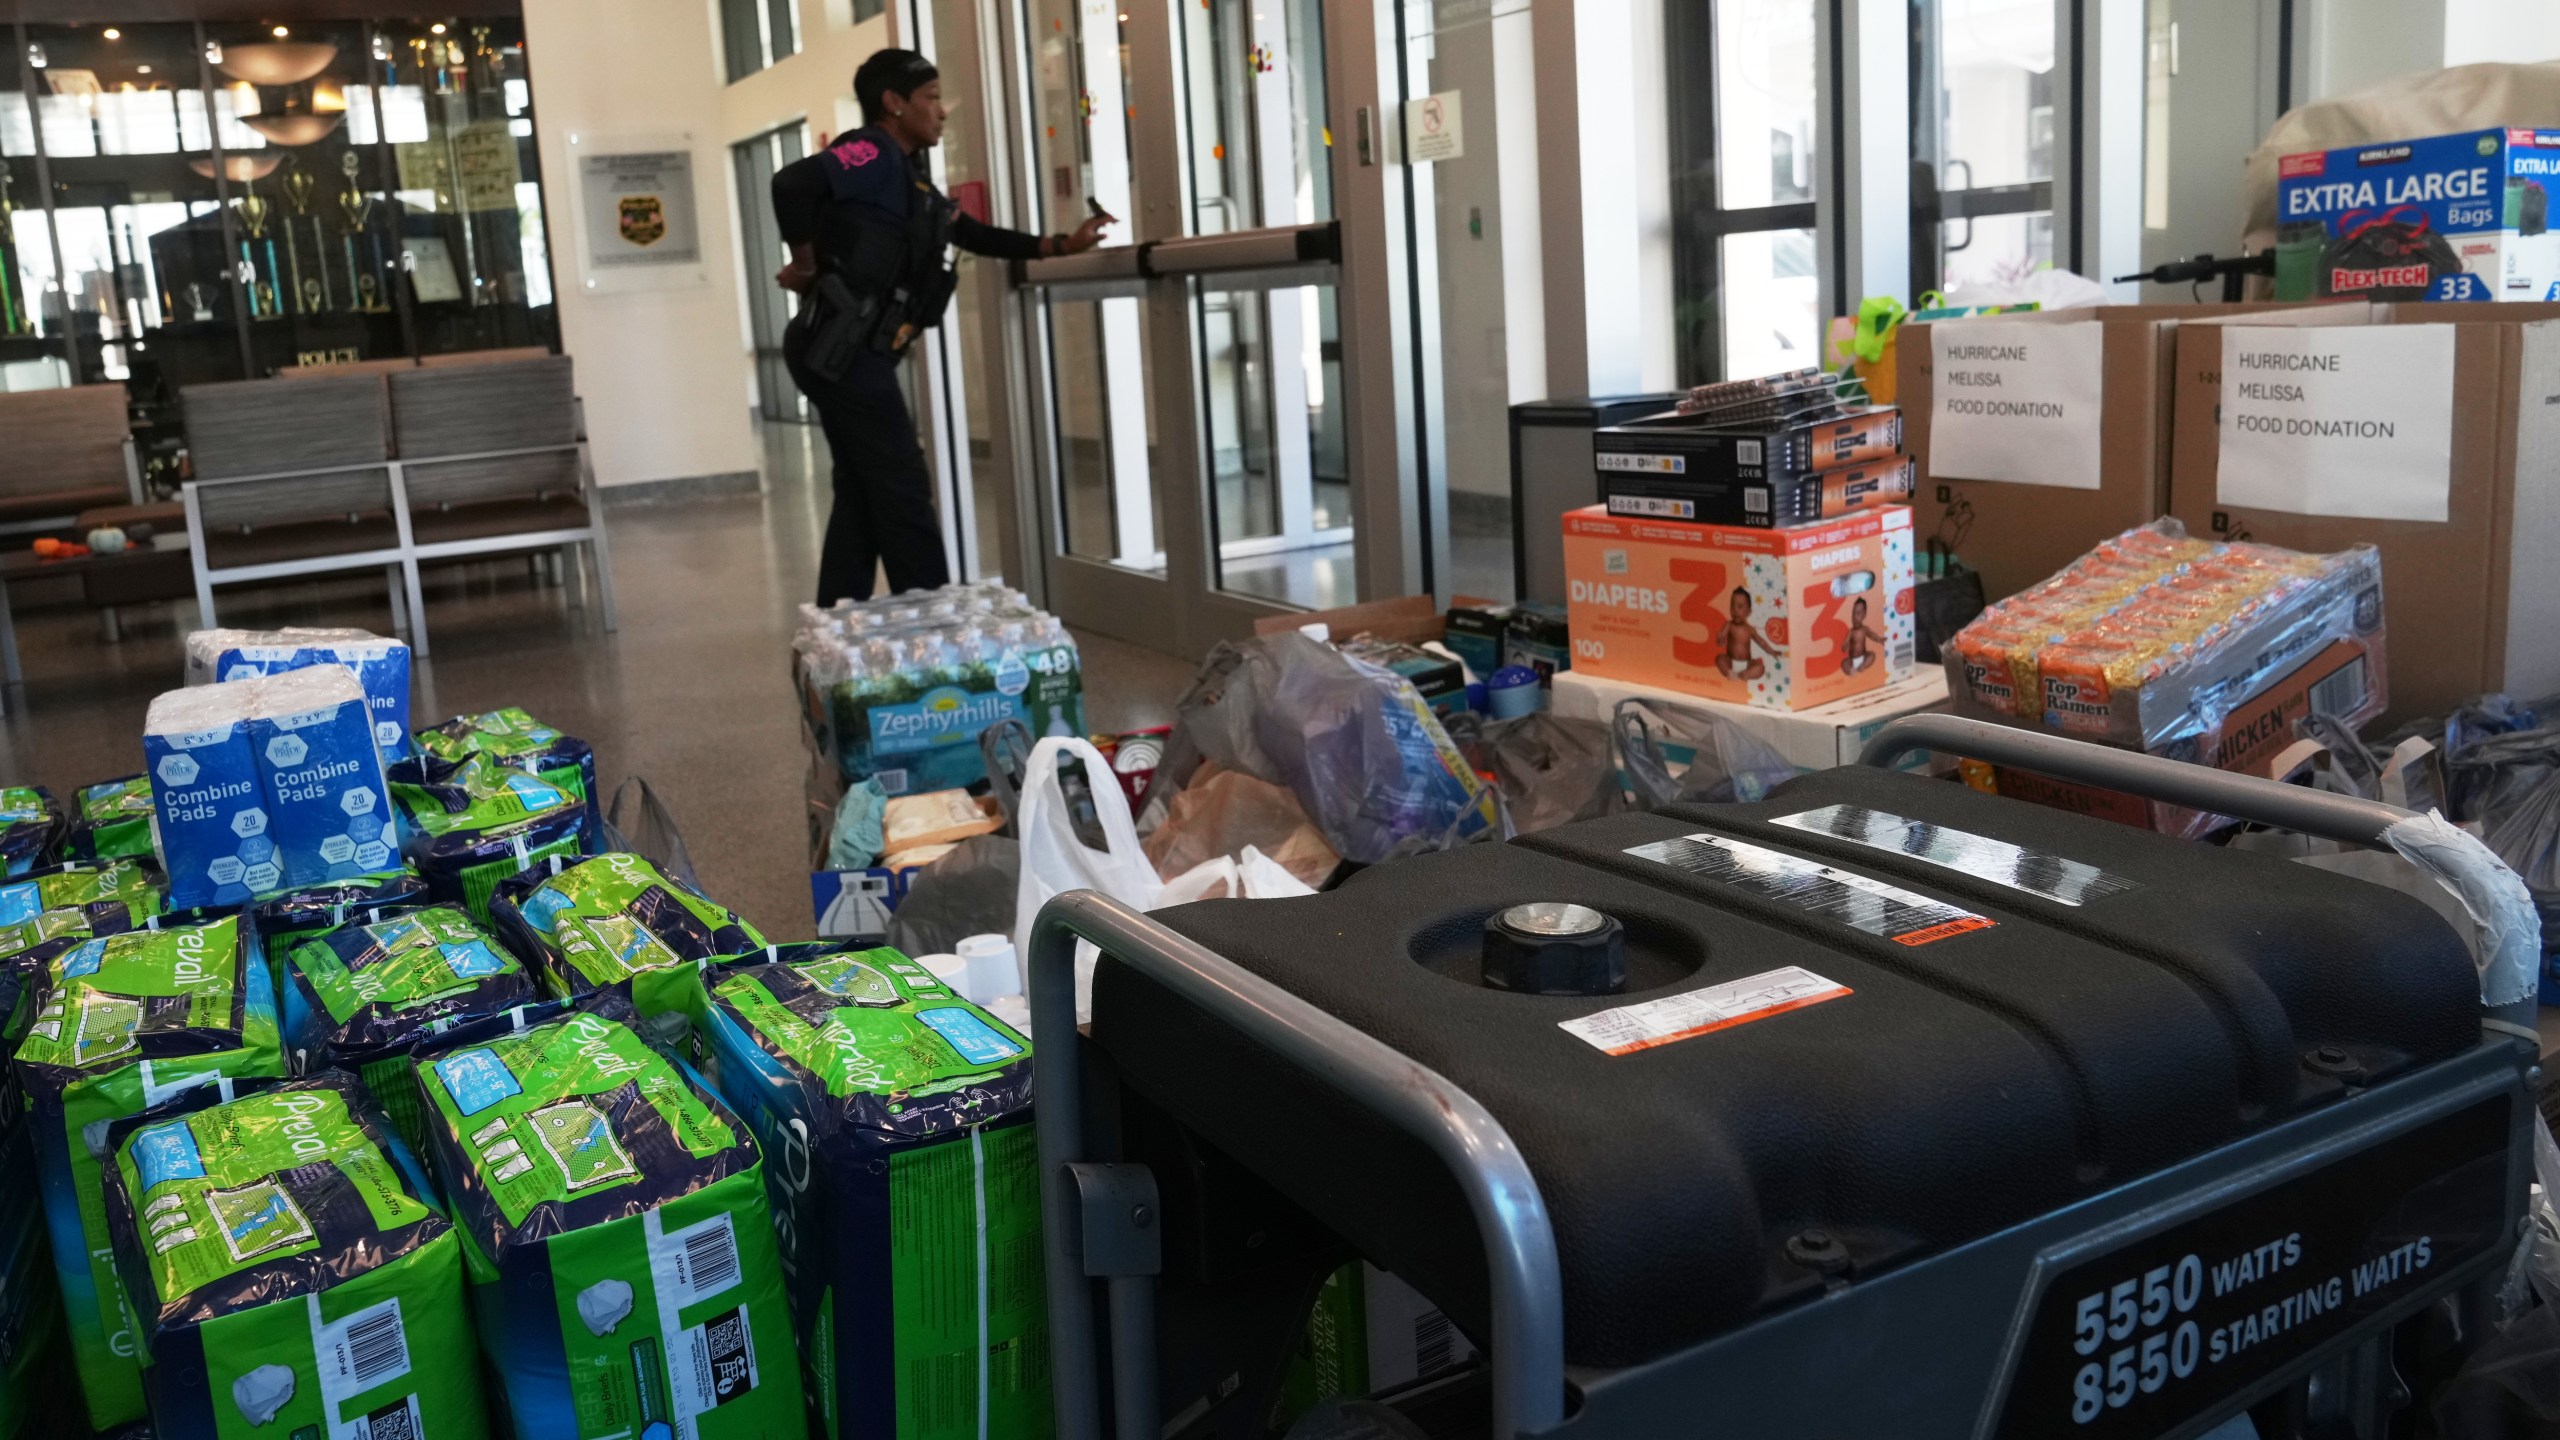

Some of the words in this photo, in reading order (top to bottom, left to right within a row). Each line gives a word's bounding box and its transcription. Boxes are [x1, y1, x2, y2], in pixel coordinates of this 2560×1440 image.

[2514, 158, 2549, 174] EXTRA
[2289, 181, 2377, 215] EXTRA
[2385, 167, 2489, 205] LARGE
[2448, 207, 2494, 227] Bags
[2332, 263, 2429, 293] FLEX-TECH
[2440, 276, 2473, 300] 33
[1948, 345, 2028, 361] HURRICANE
[2238, 353, 2341, 372] HURRICANE
[1948, 371, 2002, 387] MELISSA
[2238, 383, 2305, 402] MELISSA
[1947, 399, 1984, 415] FOOD
[1986, 401, 2064, 418] DONATION
[2237, 414, 2283, 434] FOOD
[2286, 419, 2396, 438] DONATION
[1811, 545, 1862, 570] DIAPERS
[1570, 579, 1670, 614] DIAPERS
[1669, 557, 1727, 668] 3
[1574, 639, 1605, 659] 100
[1037, 648, 1071, 676] 48
[2044, 677, 2078, 700] Top
[877, 697, 1013, 737] Zephyrhills
[2046, 695, 2111, 716] Ramen
[2213, 703, 2285, 769] HICKEN
[274, 760, 360, 788] Combine
[164, 780, 252, 807] Combine
[277, 784, 327, 805] Pads
[352, 793, 365, 806] 20
[167, 804, 217, 823] Pads
[243, 815, 256, 828] 20
[1900, 923, 1969, 945] WARNING
[676, 1254, 687, 1285] PF-013/1
[2073, 1253, 2203, 1356] 5550
[2211, 1231, 2302, 1298] WATTS
[1325, 1313, 1336, 1353] RICE
[2071, 1319, 2202, 1425] 8550
[2208, 1276, 2343, 1363] STARTING
[2351, 1235, 2432, 1298] WATTS
[335, 1343, 348, 1376] PF-013/1
[597, 1372, 612, 1400] Briefs
[602, 1401, 617, 1425] Daily
